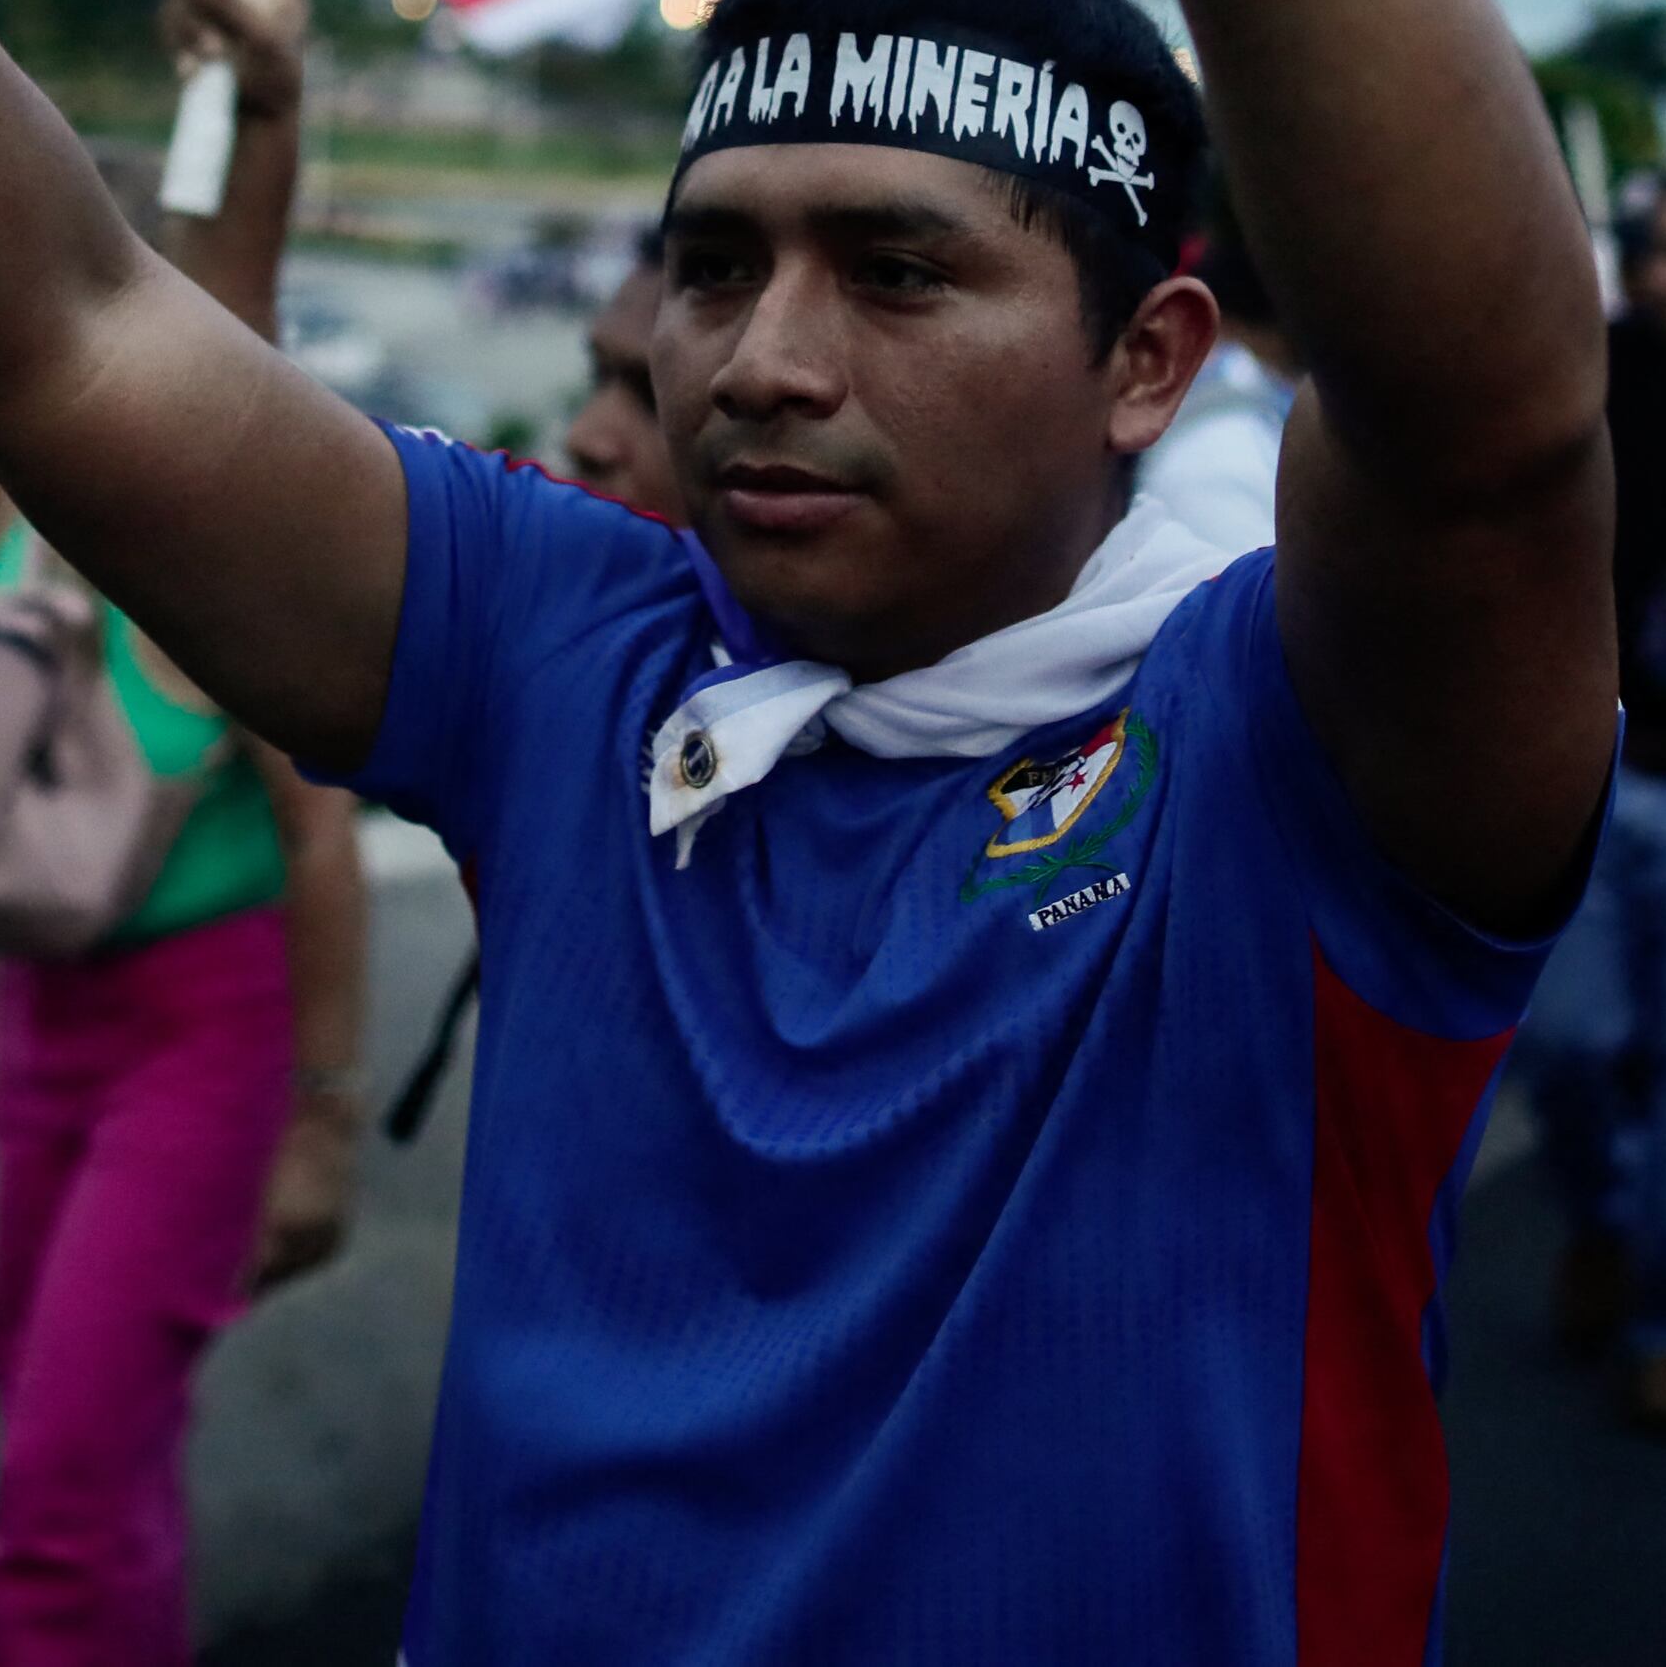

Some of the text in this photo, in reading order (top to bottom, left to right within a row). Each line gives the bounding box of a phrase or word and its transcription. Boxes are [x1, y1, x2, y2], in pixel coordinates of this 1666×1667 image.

[709, 46, 746, 135] A
[747, 32, 811, 124] LA
[829, 32, 1089, 169] MINERÍA
[1036, 876, 1125, 929] PANAMA
